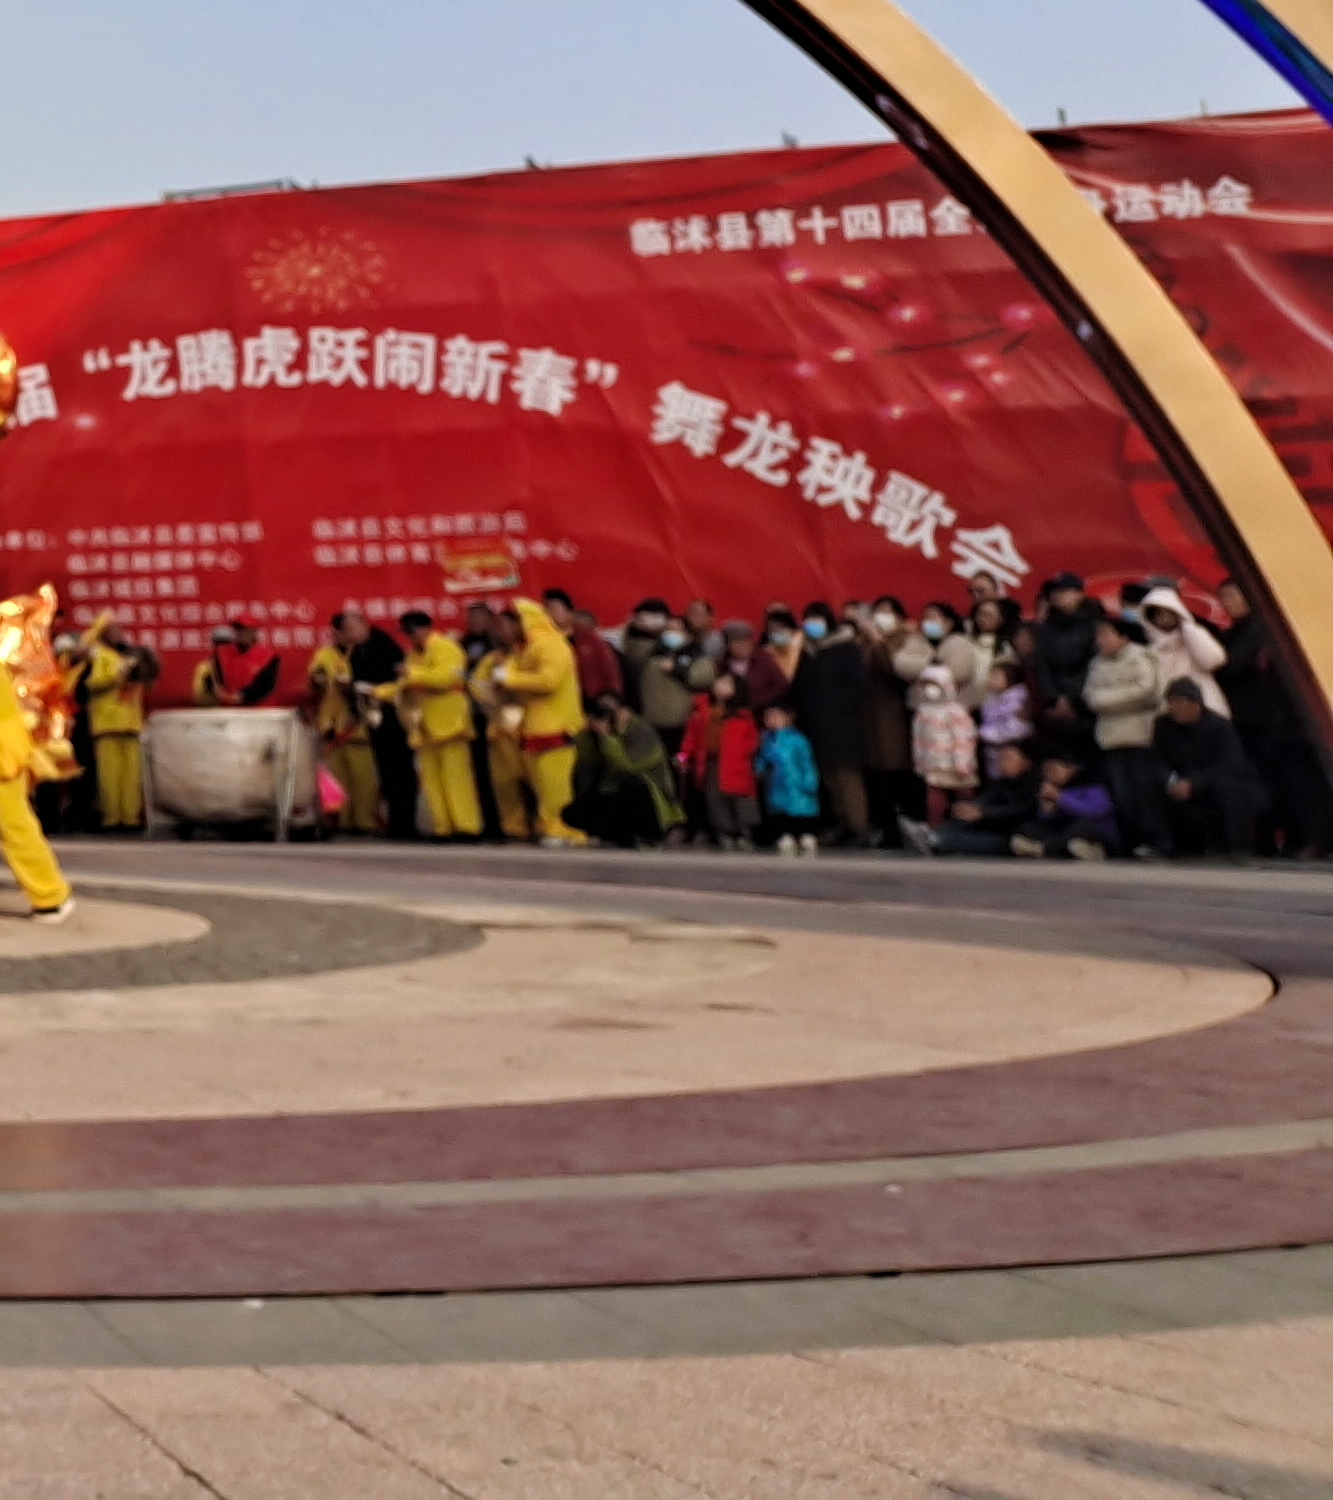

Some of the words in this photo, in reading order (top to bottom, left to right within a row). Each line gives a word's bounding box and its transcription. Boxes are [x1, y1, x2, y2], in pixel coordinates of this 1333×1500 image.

[83, 327, 619, 416] “龙腾虎跃闹新春”
[650, 381, 1030, 588] 舞龙秧歌会
